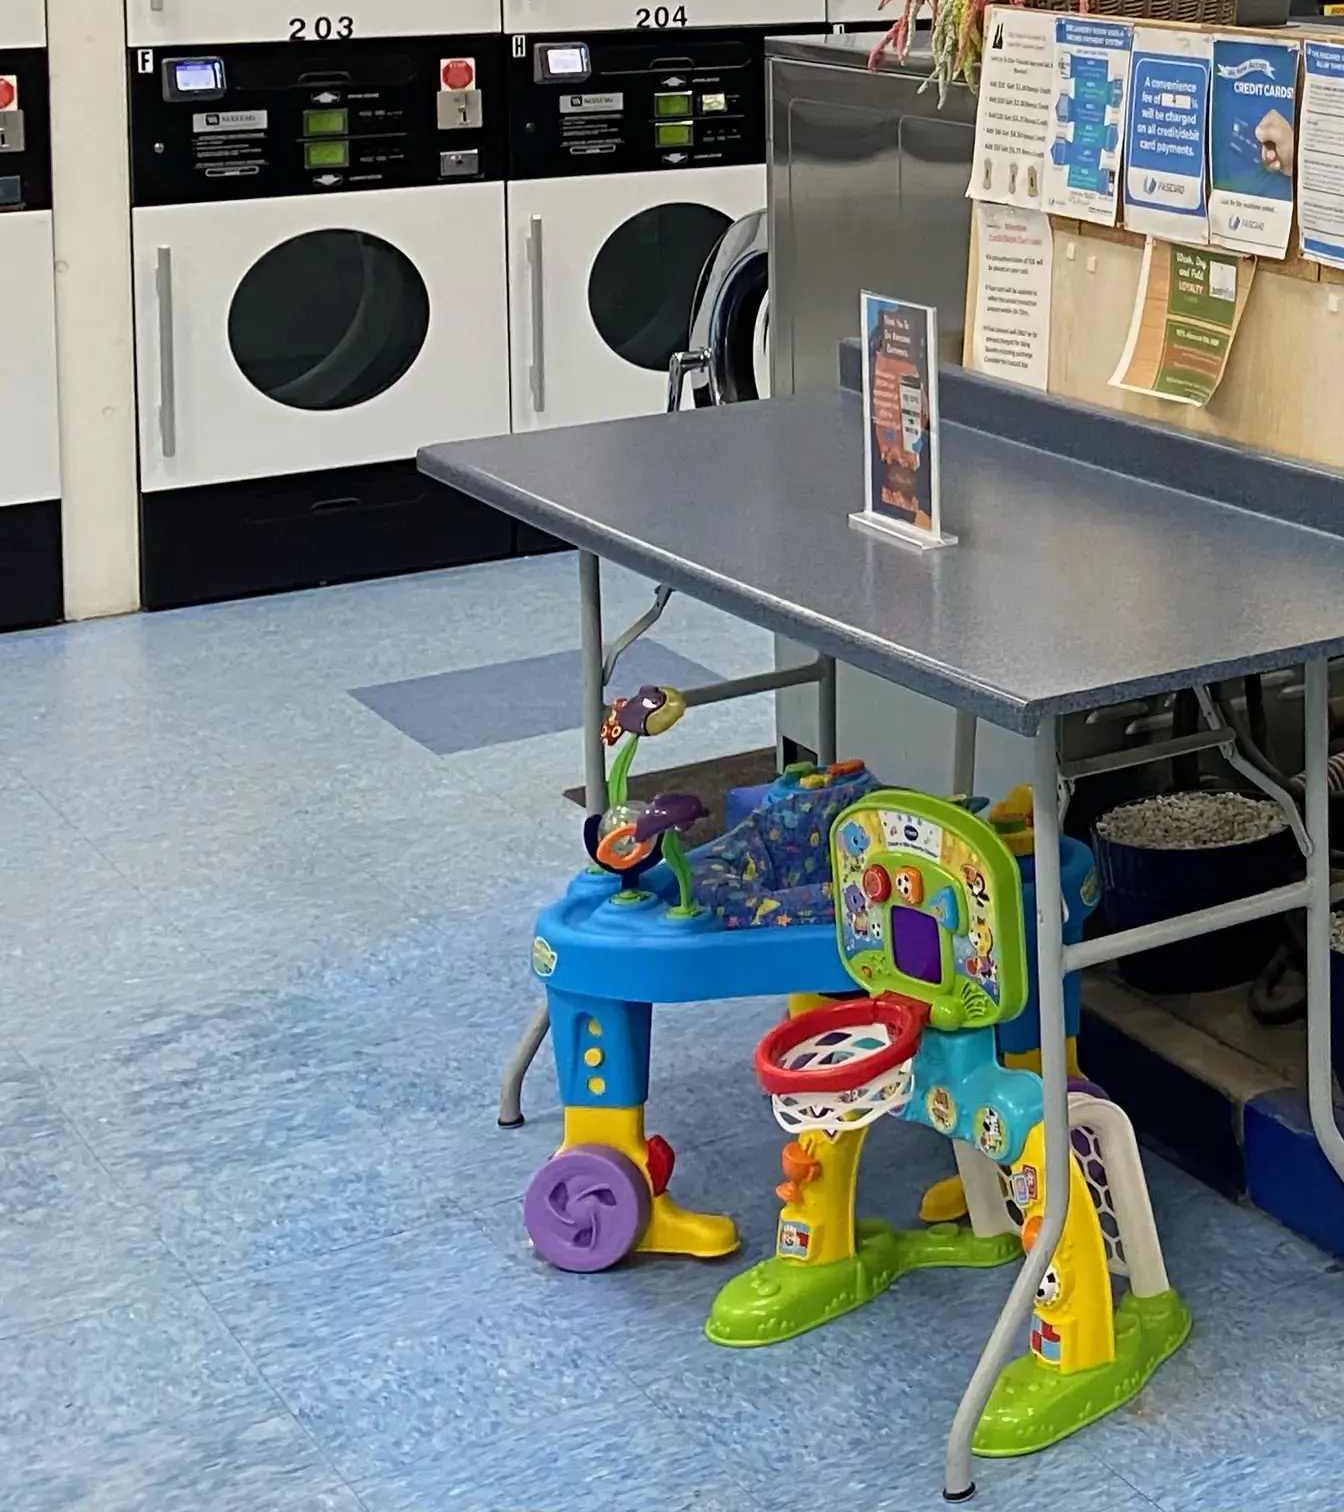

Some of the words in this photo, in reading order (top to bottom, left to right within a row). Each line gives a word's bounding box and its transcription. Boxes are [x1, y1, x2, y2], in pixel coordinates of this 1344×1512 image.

[636, 5, 688, 29] 204
[289, 16, 354, 41] 203
[513, 36, 525, 57] H
[140, 51, 151, 73] F
[1144, 76, 1150, 87] A
[1151, 79, 1197, 93] convenience
[1234, 81, 1263, 96] CREDIT
[1142, 91, 1152, 103] fee
[1141, 108, 1154, 118] will
[1155, 109, 1164, 120] be
[1165, 111, 1196, 126] charged
[1137, 124, 1146, 133] on
[1147, 124, 1156, 134] all
[1156, 126, 1199, 141] credit/debit
[1140, 139, 1156, 150] card
[1179, 280, 1204, 295] LOYALTY
